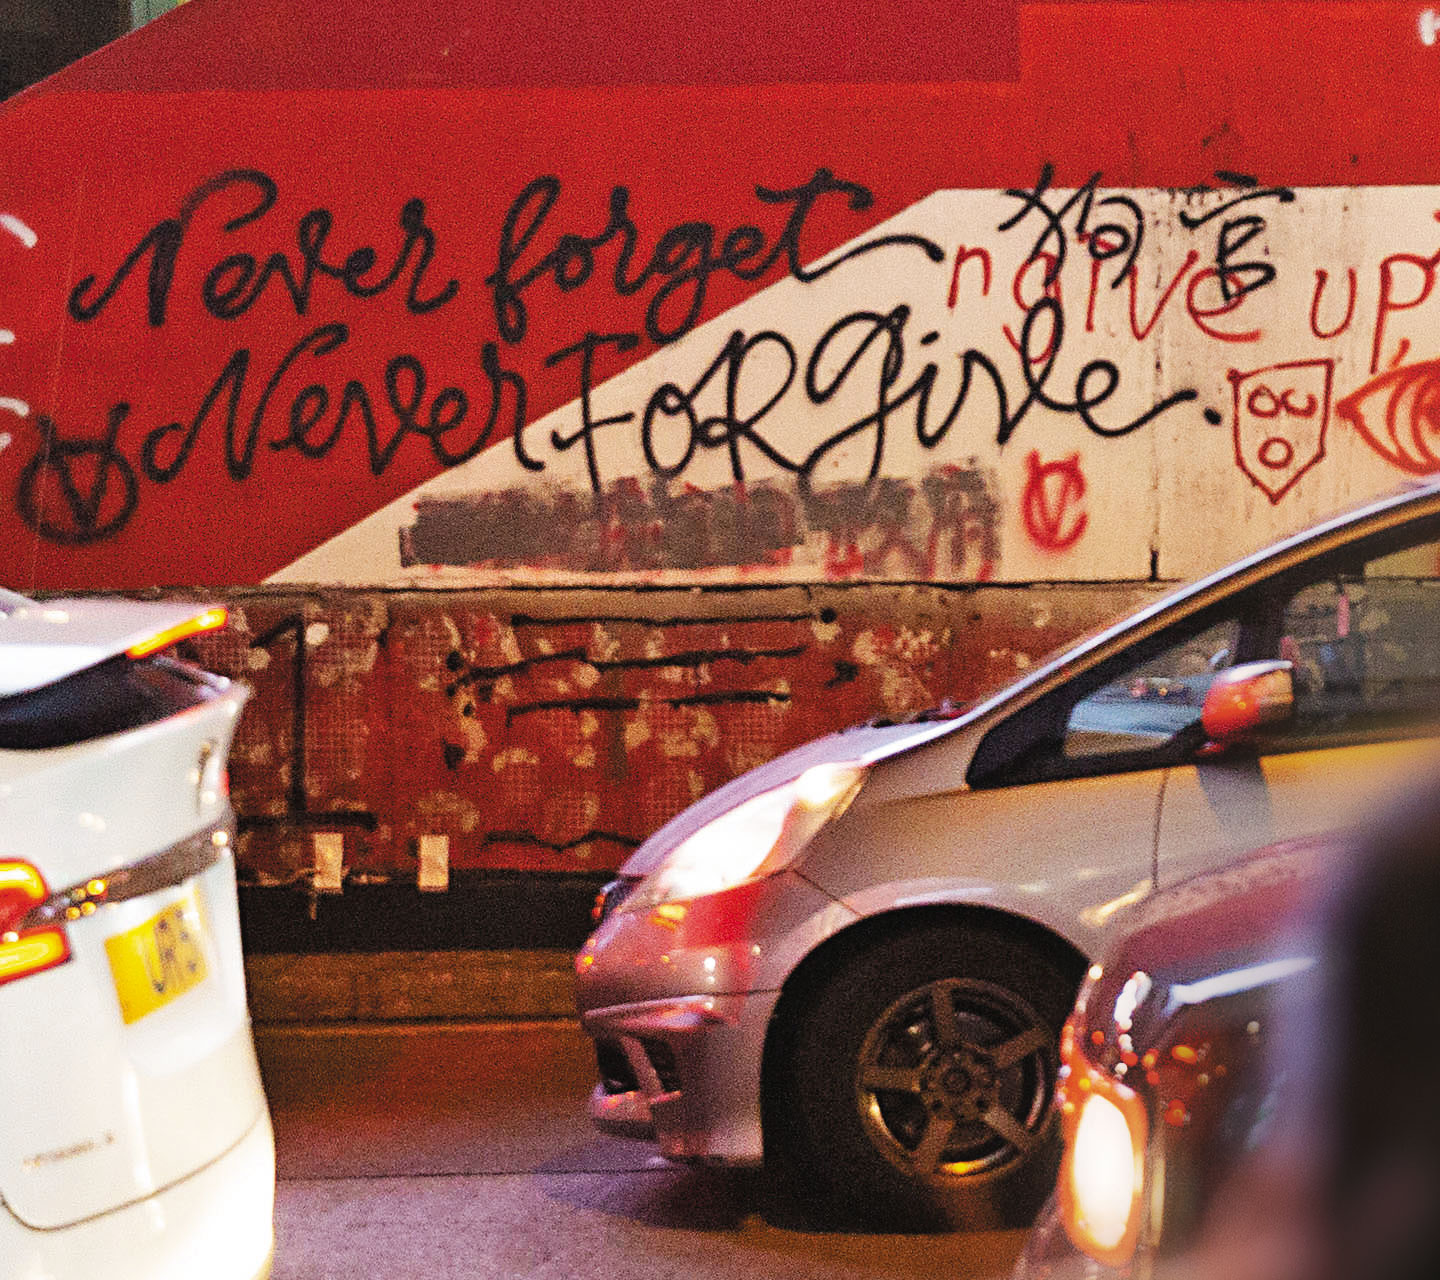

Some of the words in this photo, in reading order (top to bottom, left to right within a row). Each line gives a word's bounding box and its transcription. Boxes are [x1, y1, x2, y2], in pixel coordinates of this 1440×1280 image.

[68, 168, 459, 325] Never
[486, 174, 945, 344] forget
[139, 324, 544, 479] Never
